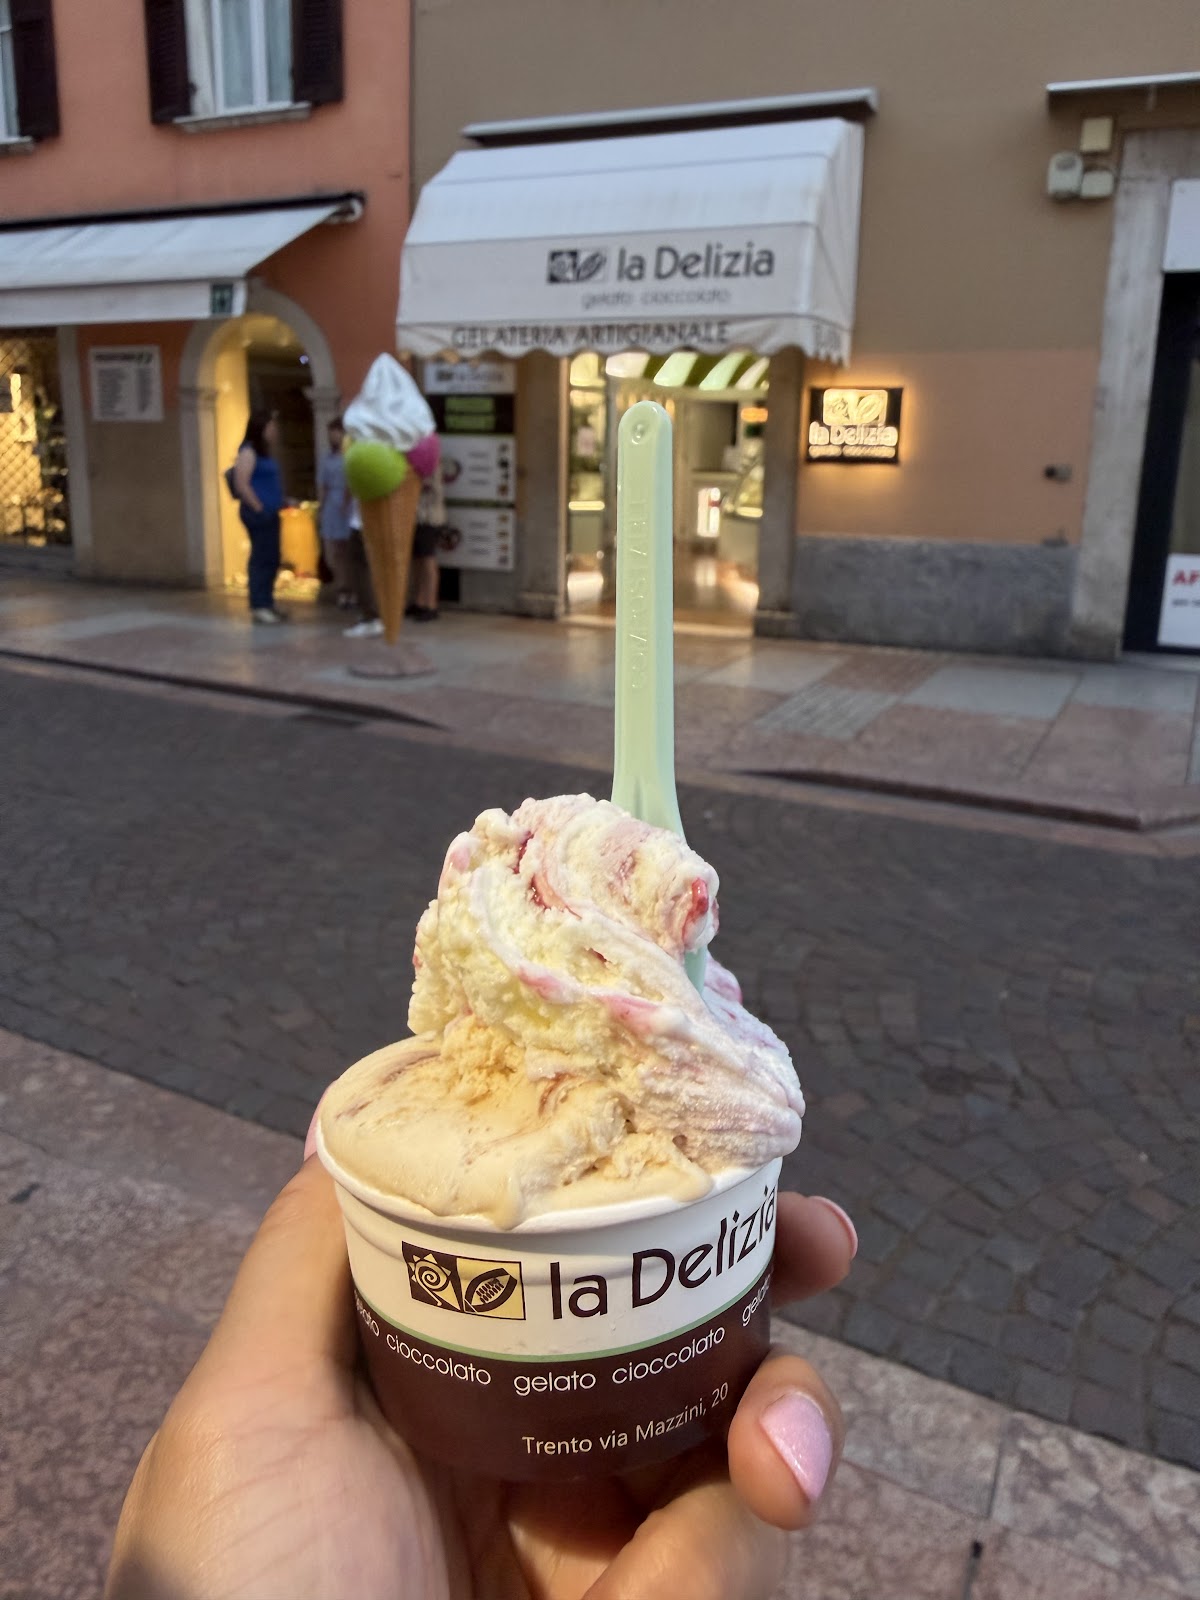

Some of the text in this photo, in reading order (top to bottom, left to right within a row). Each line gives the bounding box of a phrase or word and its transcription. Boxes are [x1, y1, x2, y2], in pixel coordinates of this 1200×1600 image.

[617, 242, 775, 281] la Delizia
[452, 320, 729, 349] GELATERIA ARTIGIANALE
[550, 1185, 776, 1320] la Delizia
[386, 1333, 492, 1385] cioccolato
[513, 1370, 597, 1397] gelato
[611, 1326, 726, 1384] cioccolato
[521, 1381, 729, 1455] Trento via Mazzini, 20
